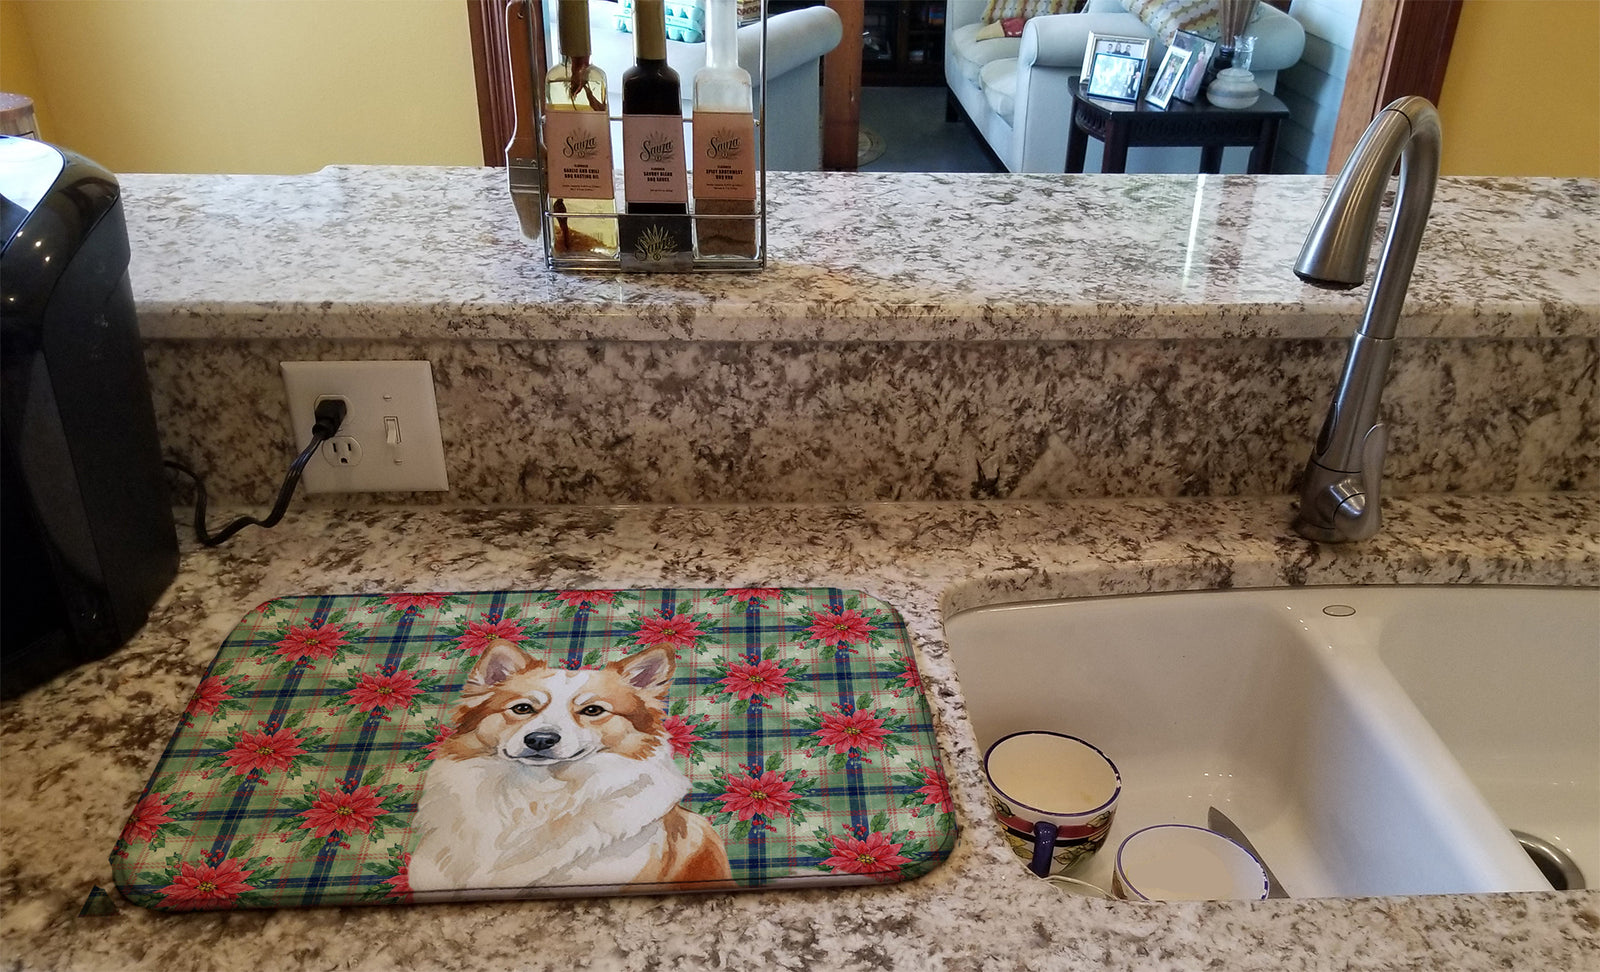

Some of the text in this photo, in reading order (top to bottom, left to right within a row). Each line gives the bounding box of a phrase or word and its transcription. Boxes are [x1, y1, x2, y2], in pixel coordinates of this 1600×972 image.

[563, 136, 597, 159] Sauza
[639, 140, 673, 162] Sauza
[706, 136, 740, 159] Sauza
